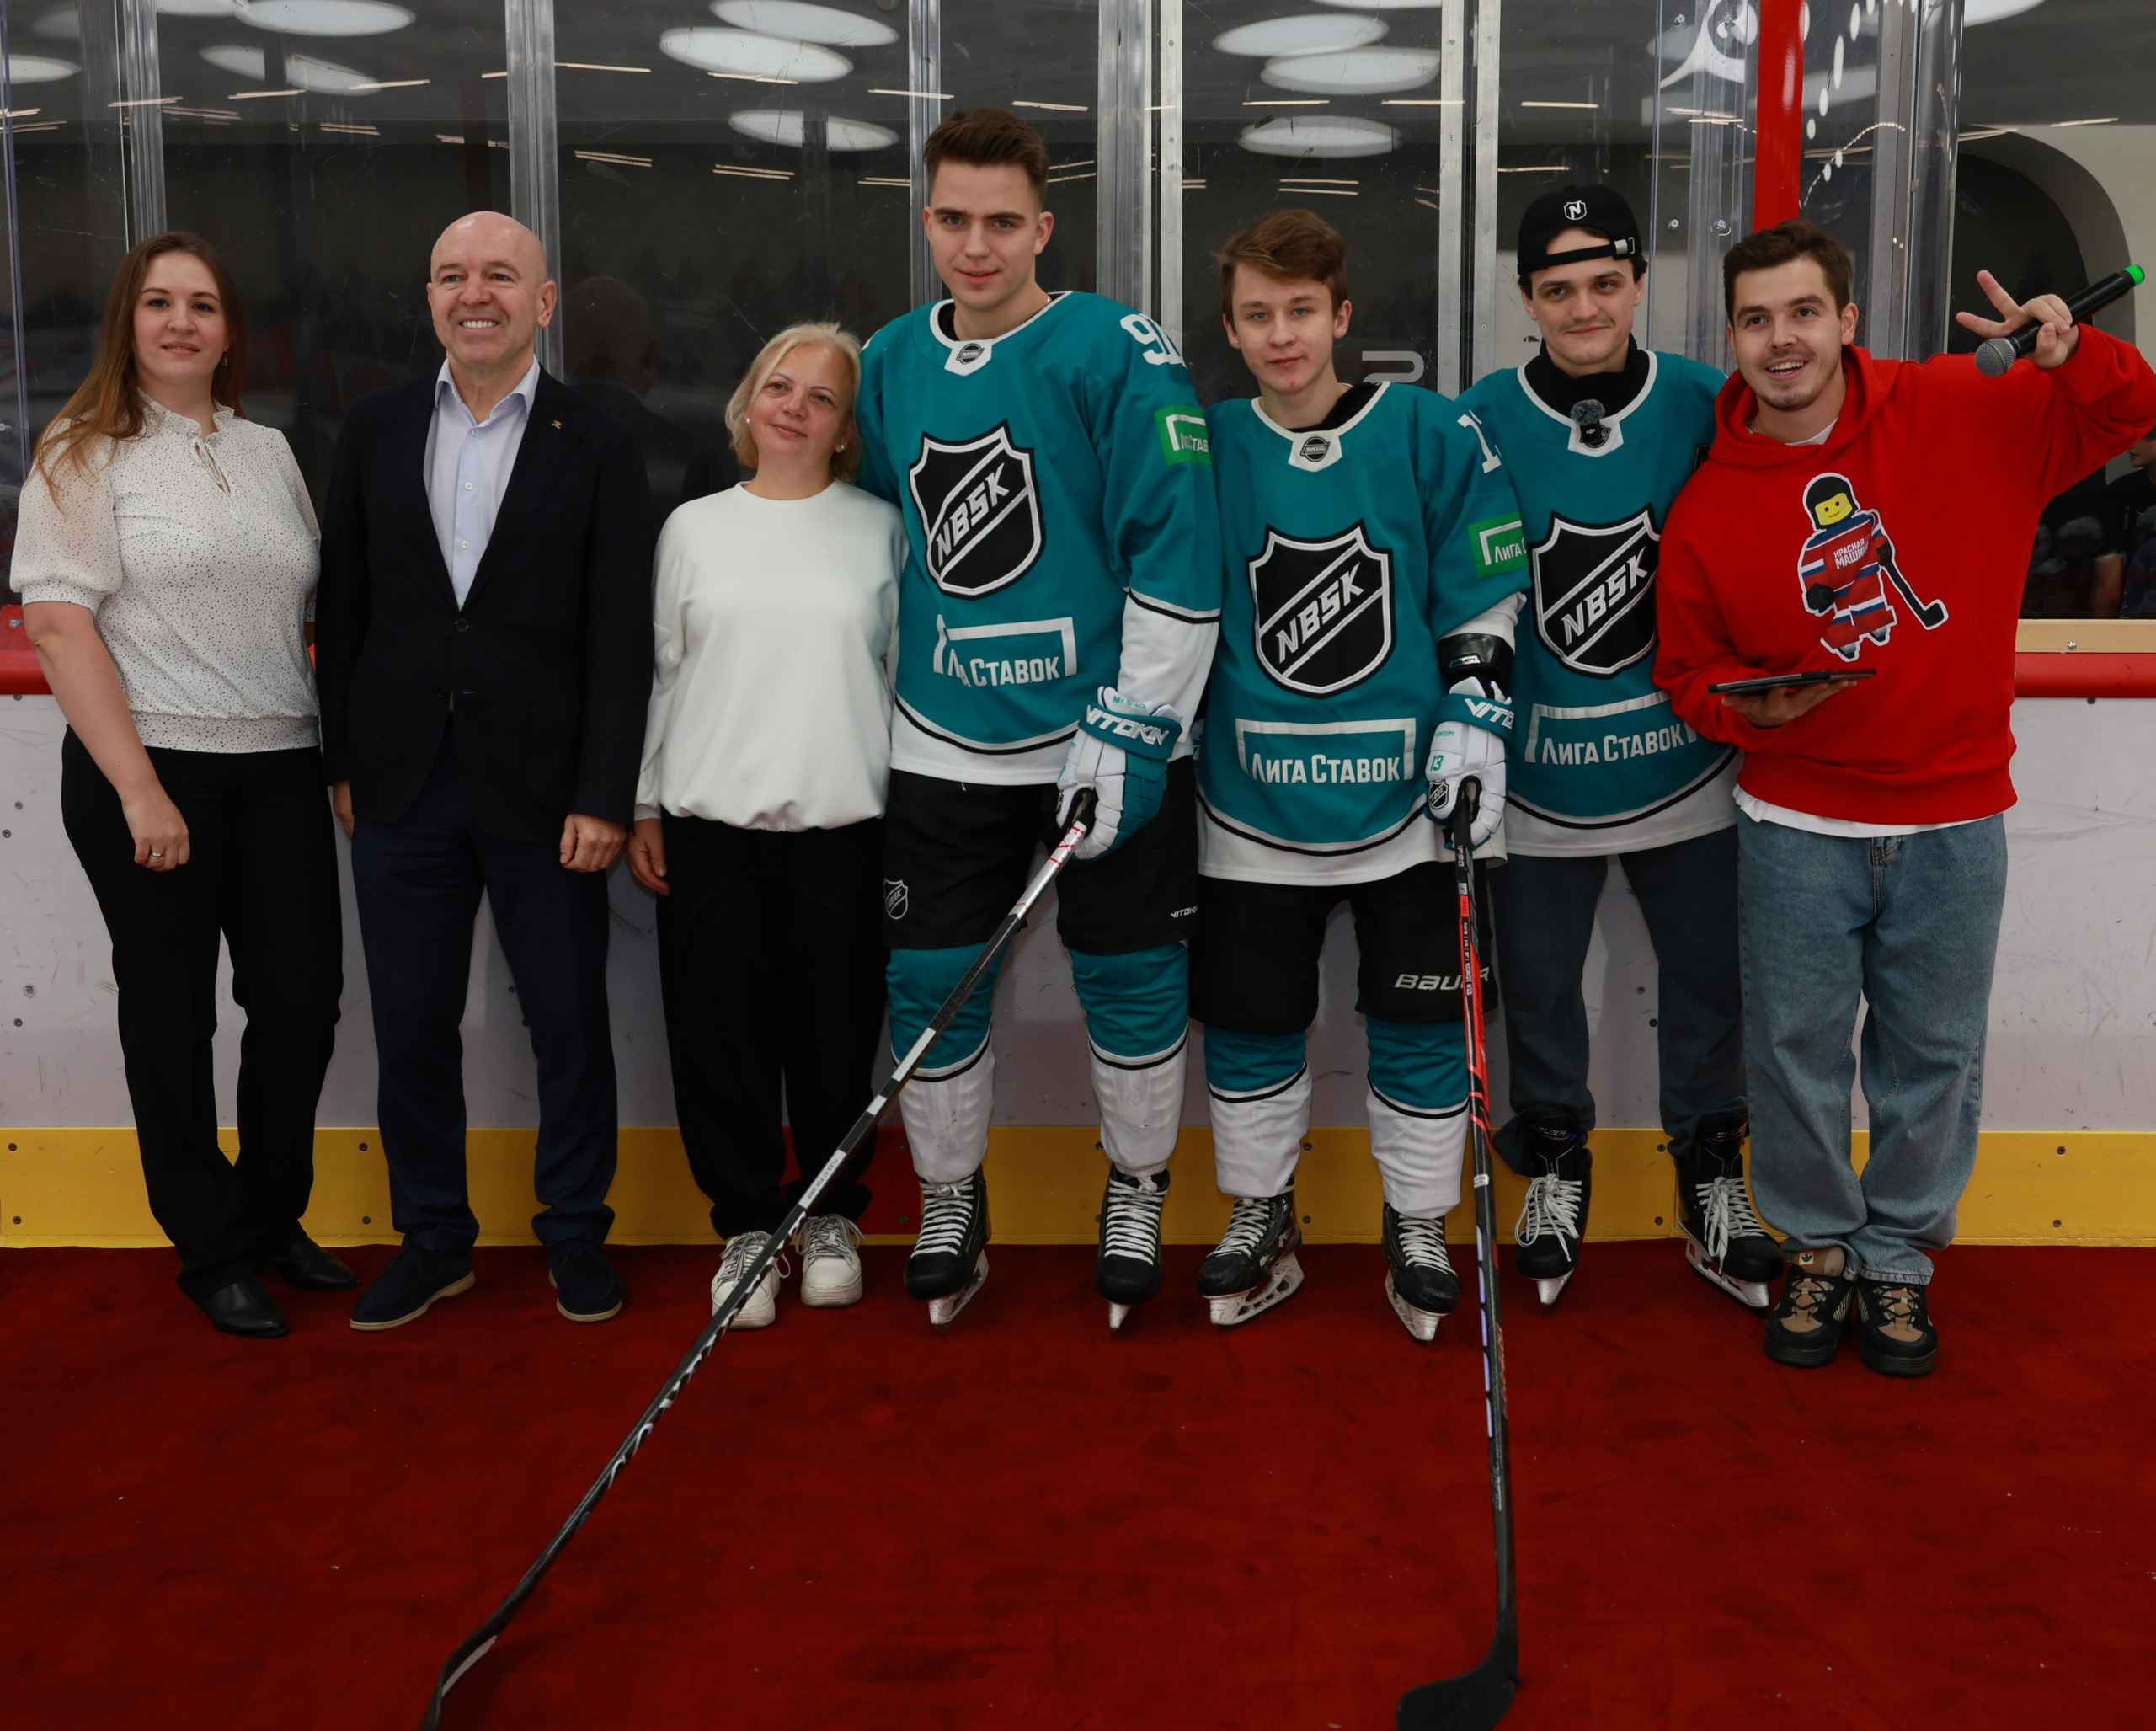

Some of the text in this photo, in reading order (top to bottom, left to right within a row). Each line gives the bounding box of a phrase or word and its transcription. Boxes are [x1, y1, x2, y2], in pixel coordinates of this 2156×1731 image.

[936, 462, 1009, 568] NBSK
[1275, 562, 1364, 664] NBSK
[1561, 545, 1648, 646] NBSK
[1086, 704, 1169, 745] VITOKIN
[1430, 755, 1444, 771] 13
[1394, 967, 1489, 991] BAUR
